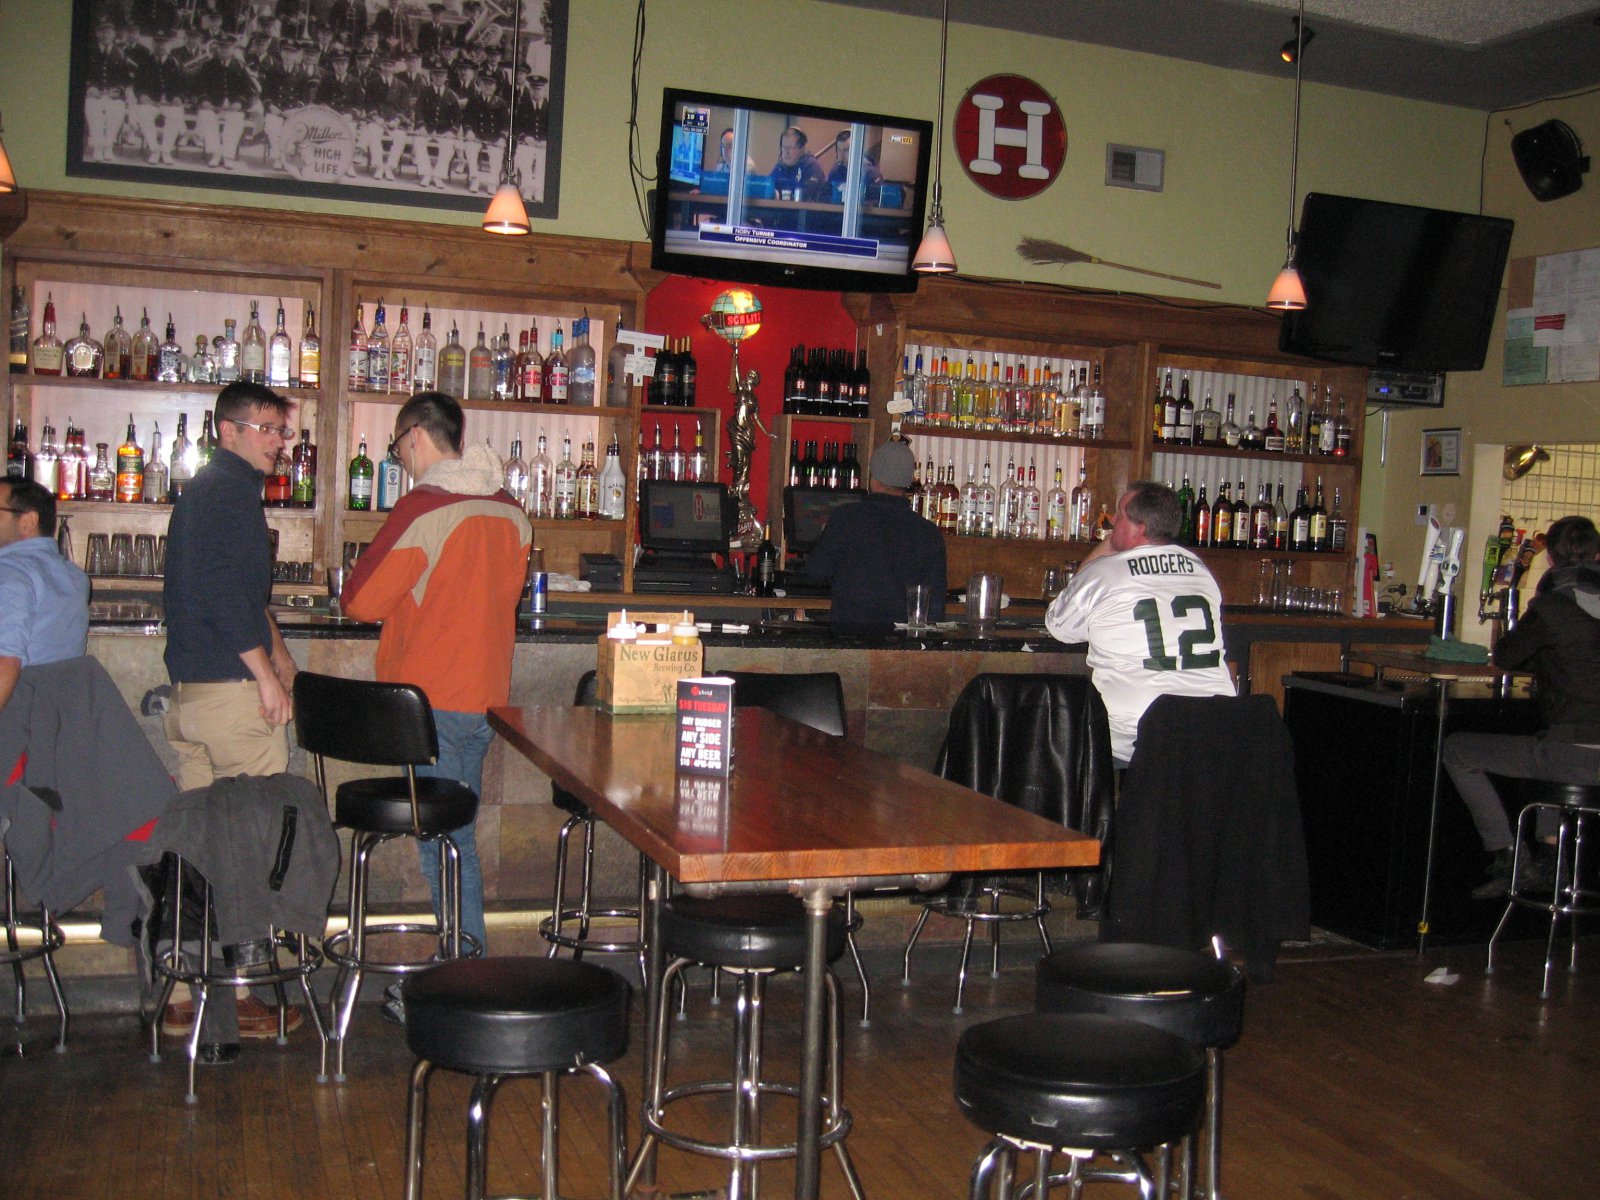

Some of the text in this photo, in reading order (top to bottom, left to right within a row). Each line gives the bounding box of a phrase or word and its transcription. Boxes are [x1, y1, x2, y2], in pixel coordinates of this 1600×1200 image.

[303, 125, 344, 141] Miller
[969, 94, 1051, 180] H
[314, 148, 341, 160] HIGH
[314, 163, 338, 175] LIFE
[751, 229, 775, 238] TURNER
[735, 236, 807, 249] OFFENSIVE COORDINATOR
[1127, 553, 1194, 576] RODGERS
[1133, 594, 1220, 671] 12
[620, 645, 698, 662] New Glarus
[653, 663, 696, 673] Brewing Co.
[694, 702, 727, 713] TUESDAY
[682, 716, 694, 725] ANY
[681, 730, 721, 746] ANY SIDE
[680, 747, 721, 761] ANY BEER
